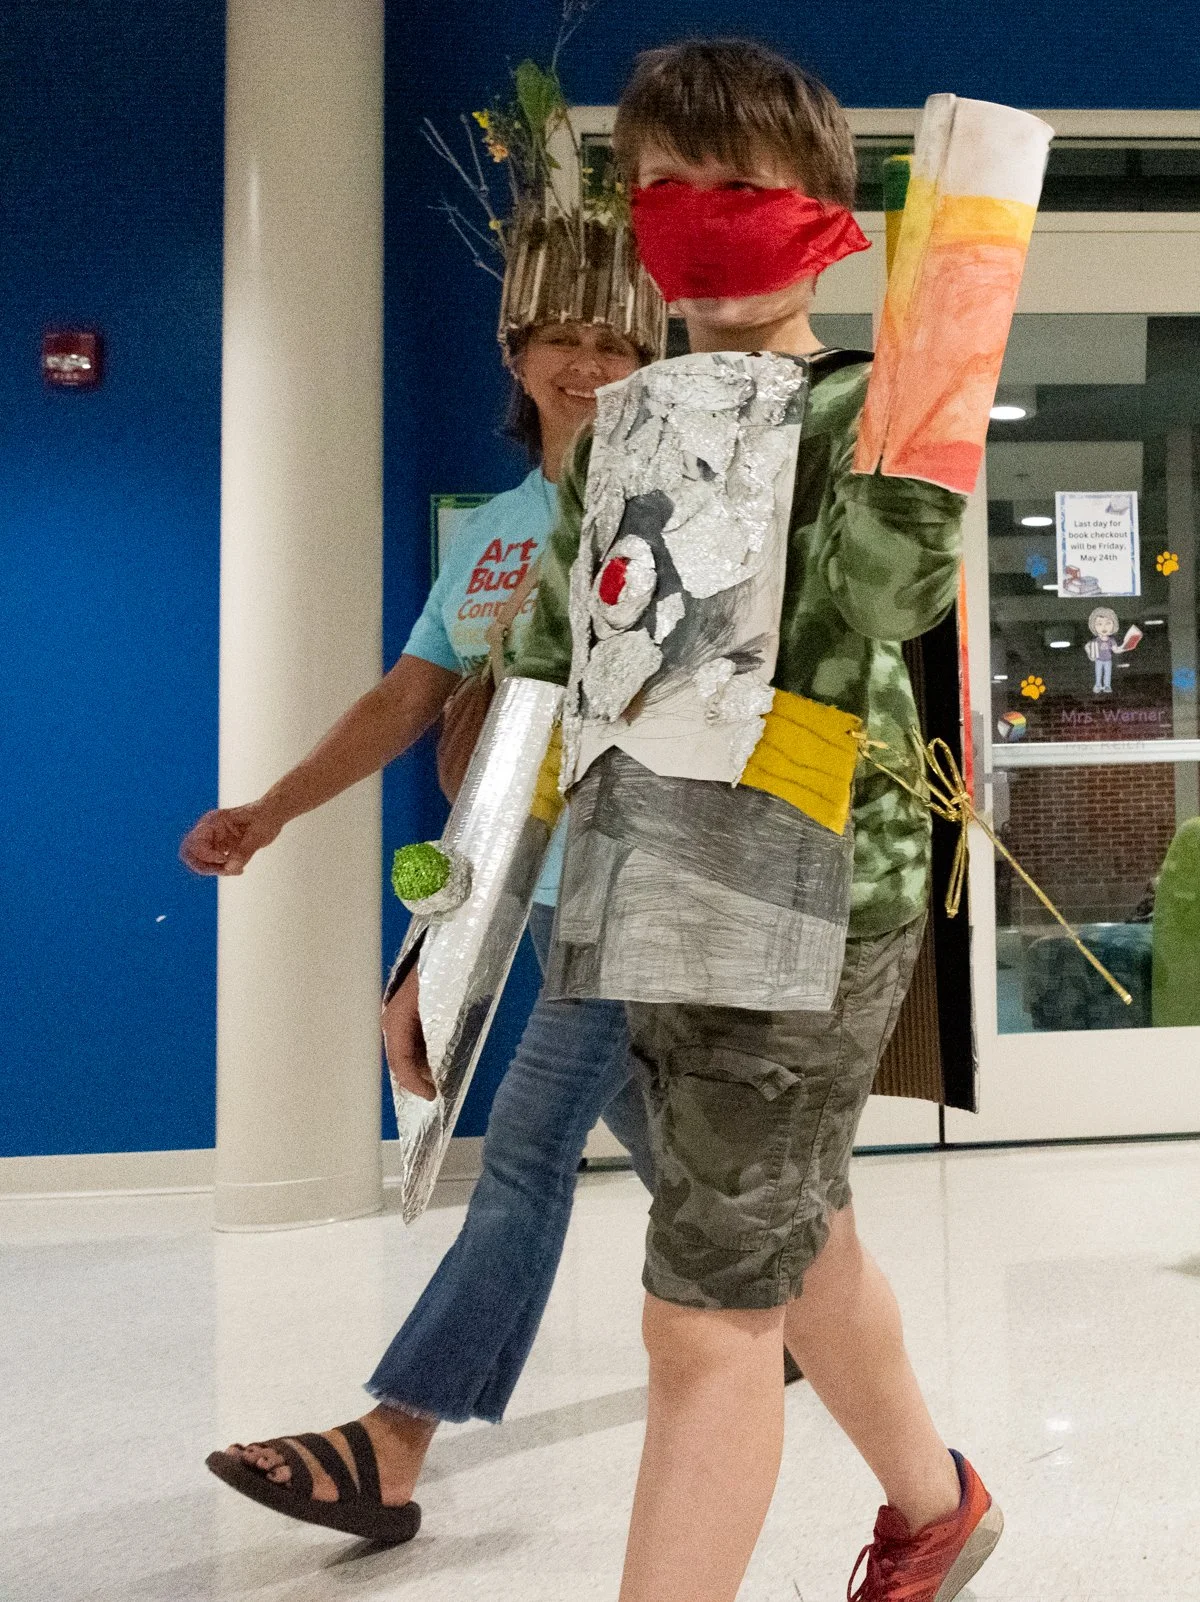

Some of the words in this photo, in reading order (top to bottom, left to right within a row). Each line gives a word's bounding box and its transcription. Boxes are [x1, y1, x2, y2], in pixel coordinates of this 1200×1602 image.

[1093, 520, 1107, 529] day
[476, 537, 539, 567] Art
[1080, 555, 1097, 563] May
[465, 563, 529, 595] Bud
[1102, 708, 1166, 723] Werner
